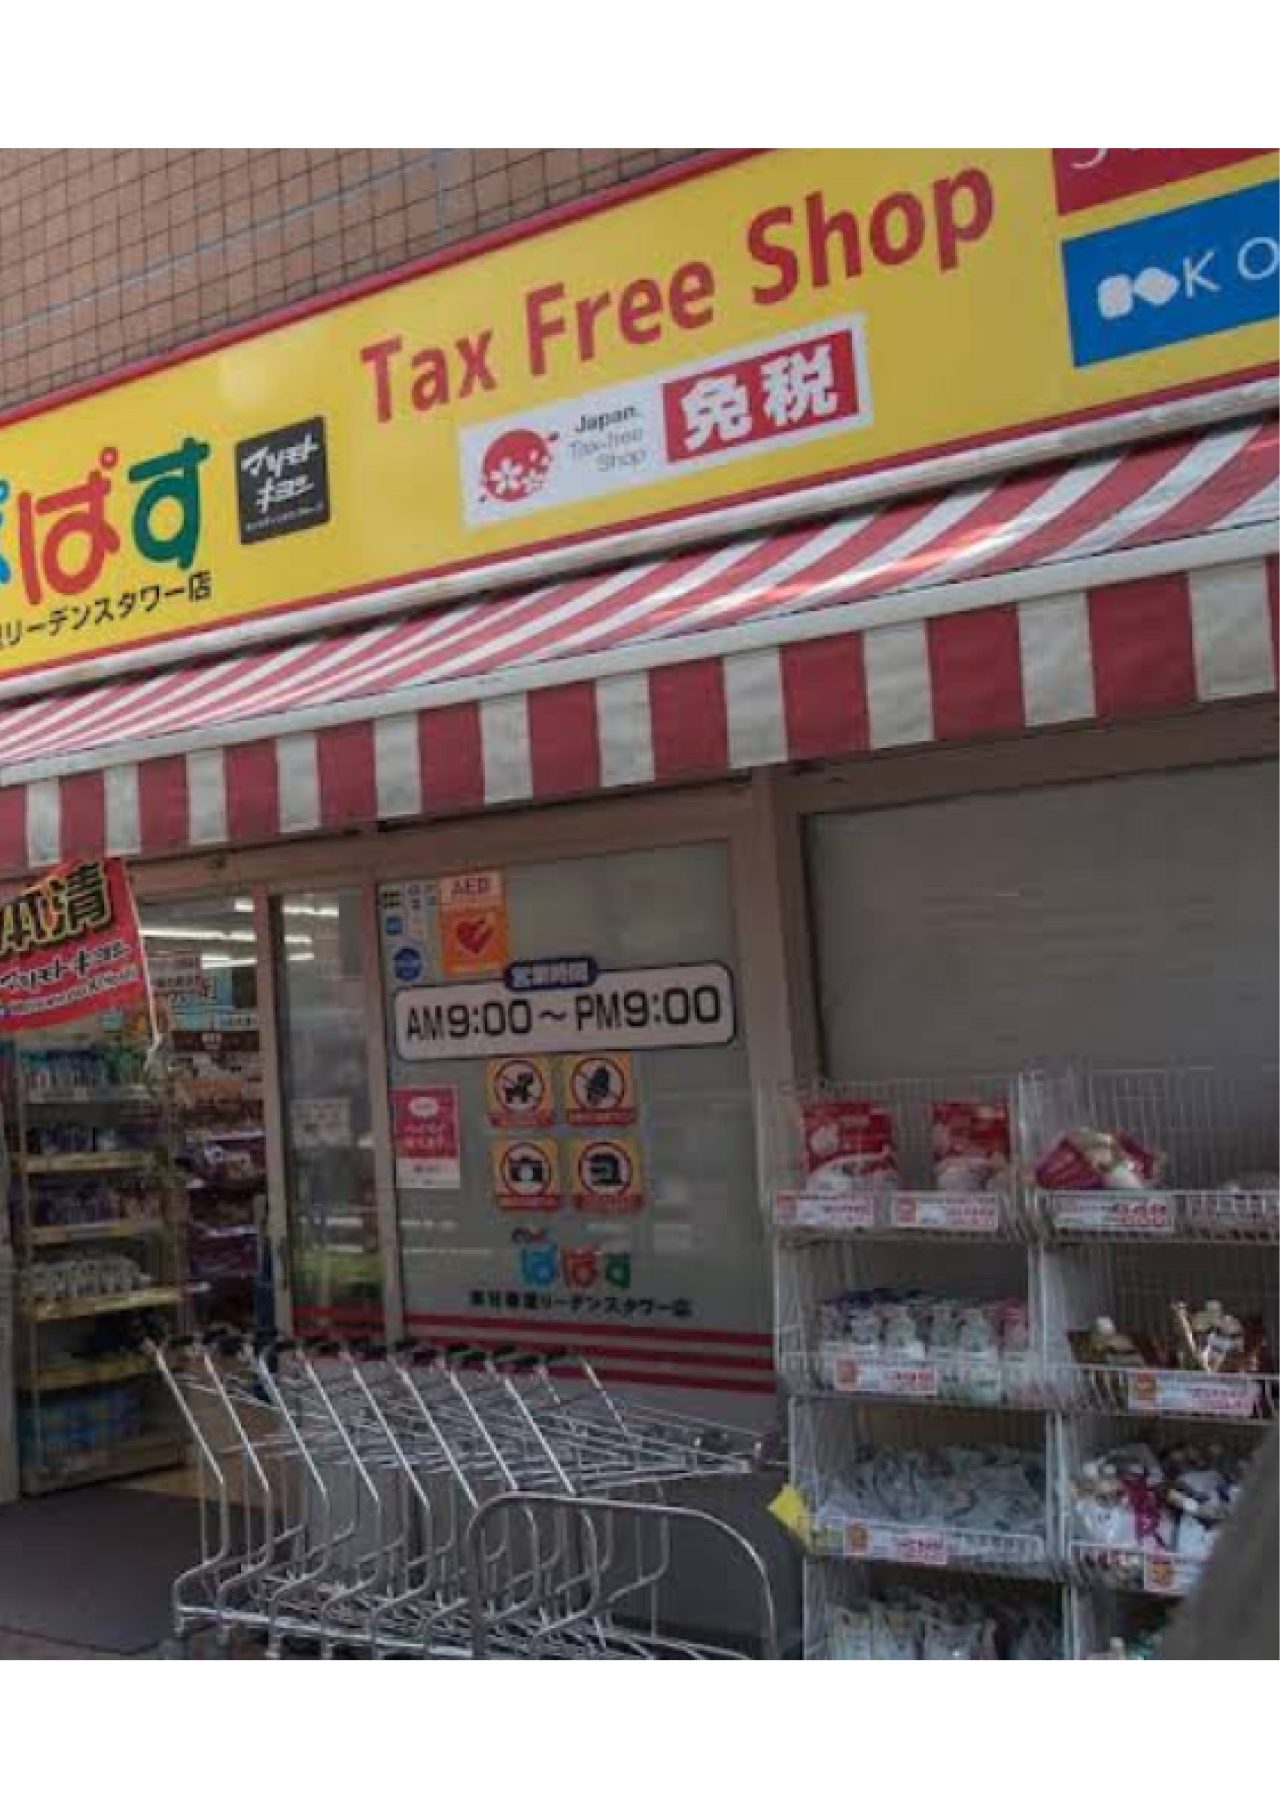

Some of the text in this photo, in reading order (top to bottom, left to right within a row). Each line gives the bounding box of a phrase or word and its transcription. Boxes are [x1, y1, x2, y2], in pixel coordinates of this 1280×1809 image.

[360, 167, 995, 424] Tax Free Shop
[678, 345, 839, 452] 免税
[596, 449, 647, 473] Shop
[451, 877, 490, 895] AED
